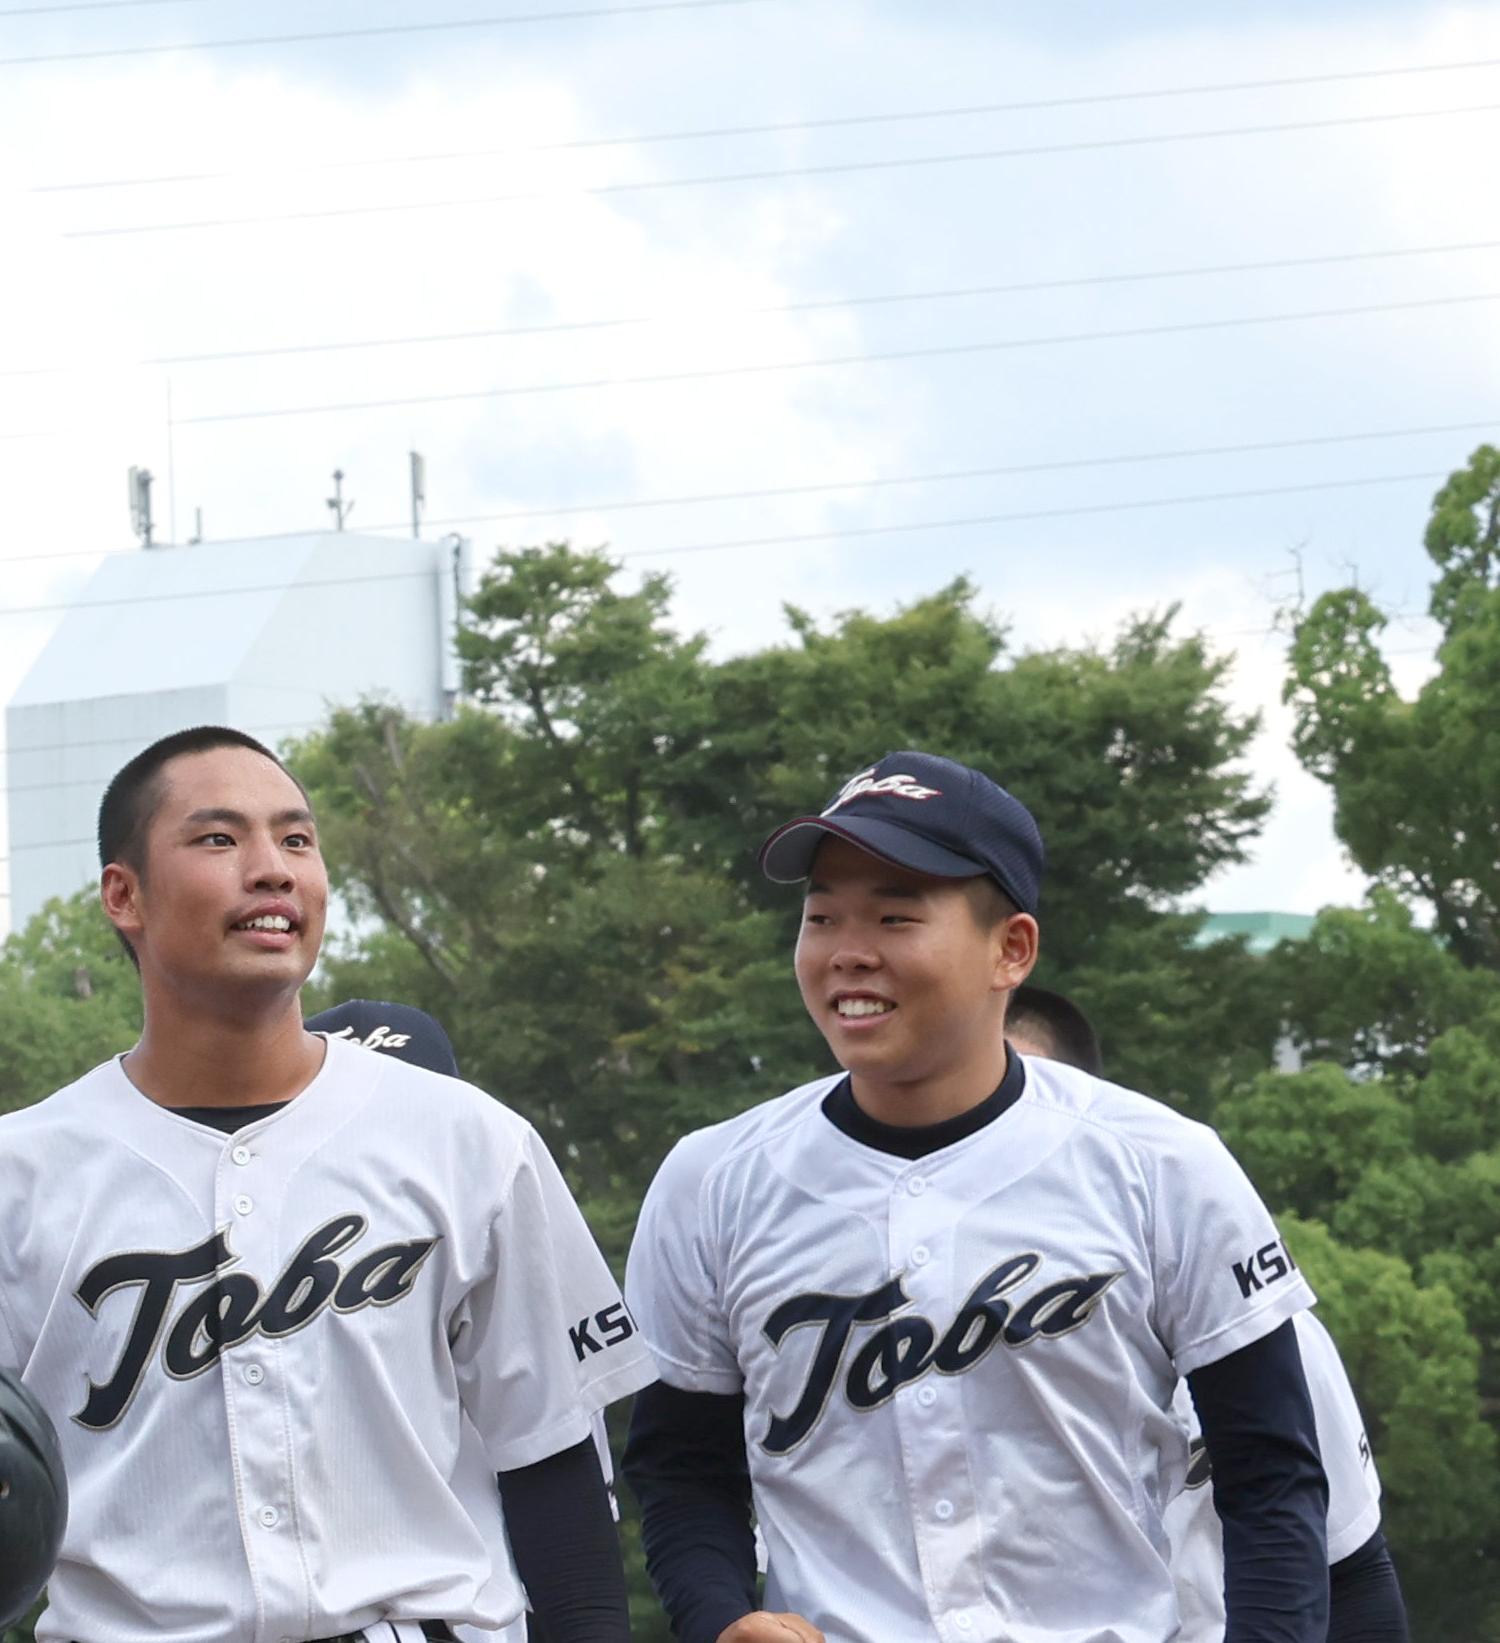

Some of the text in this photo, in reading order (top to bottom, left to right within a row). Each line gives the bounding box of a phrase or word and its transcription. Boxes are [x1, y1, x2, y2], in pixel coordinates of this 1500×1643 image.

[70, 1211, 445, 1430] Toba
[568, 1301, 639, 1363] KS
[1231, 1240, 1296, 1300] KS
[762, 1252, 1127, 1458] Toba
